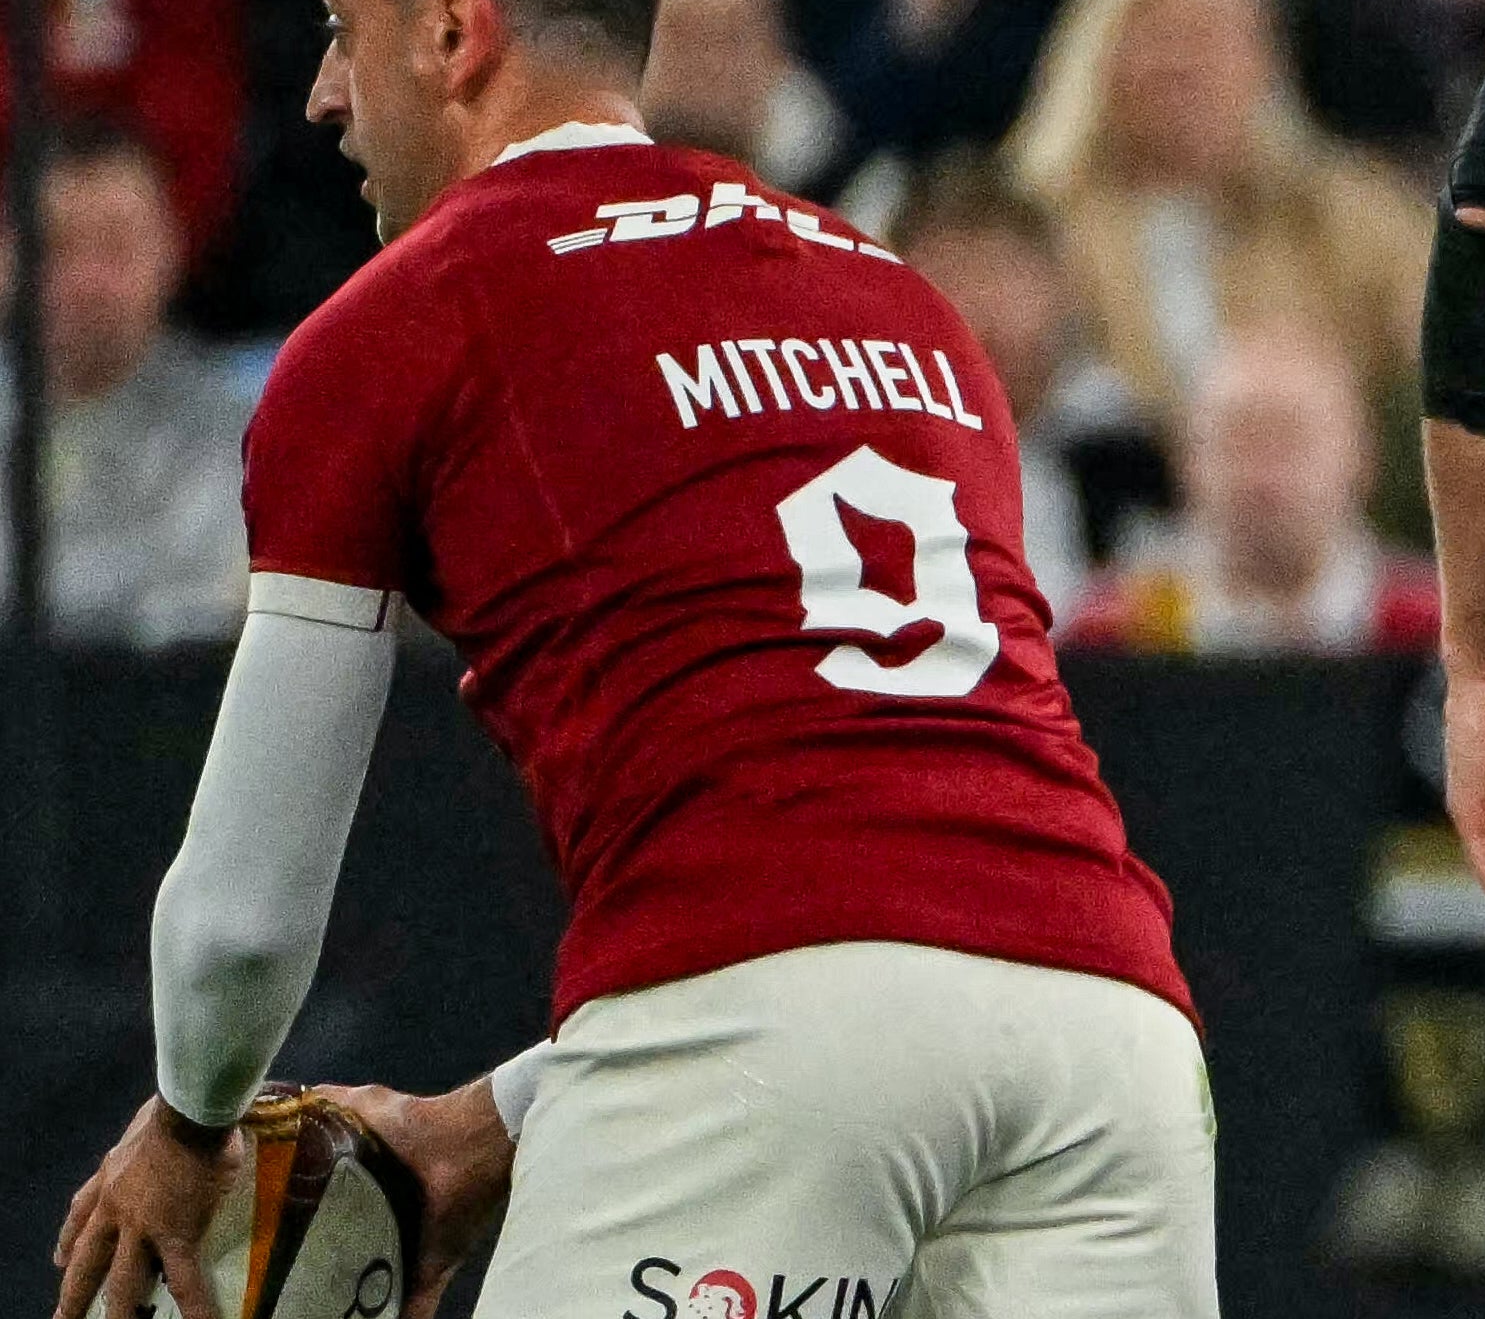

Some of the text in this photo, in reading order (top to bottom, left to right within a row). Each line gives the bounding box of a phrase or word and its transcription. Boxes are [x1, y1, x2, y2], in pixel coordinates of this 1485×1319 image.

[595, 182, 855, 252] DHL
[655, 337, 983, 430] MITCHELL
[776, 443, 1000, 698] 9
